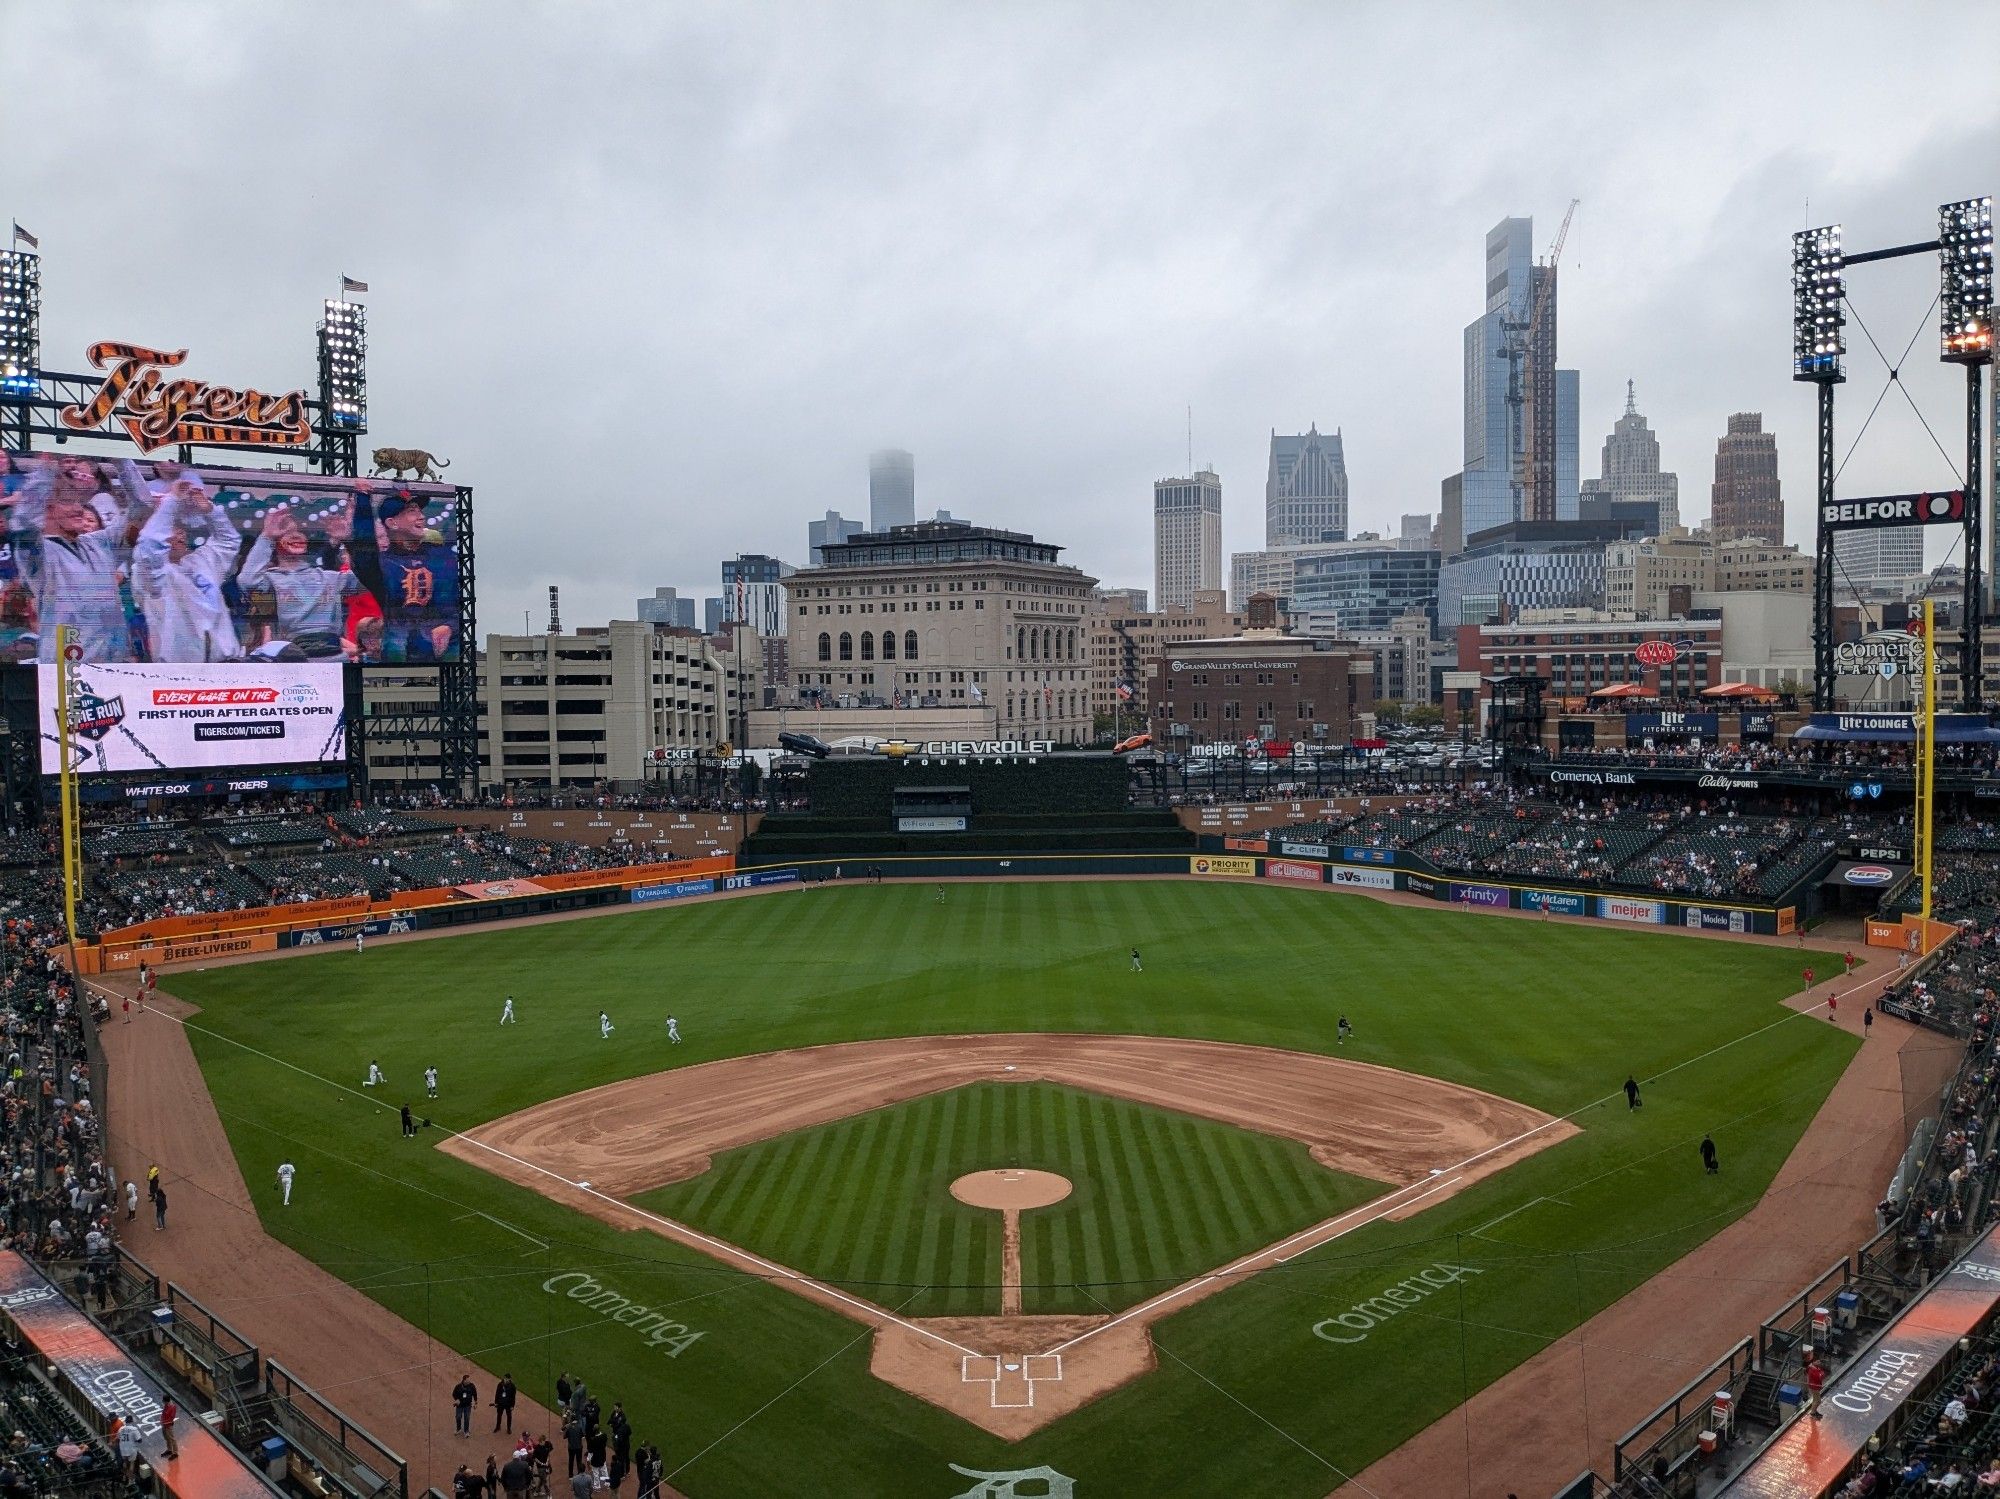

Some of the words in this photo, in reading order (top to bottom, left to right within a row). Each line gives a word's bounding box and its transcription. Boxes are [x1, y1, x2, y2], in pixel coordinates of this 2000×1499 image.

[60, 340, 312, 456] Tigers
[1824, 500, 1912, 522] BELFOR
[1906, 603, 1926, 706] ROCKET
[157, 692, 193, 704] EVERY
[197, 691, 228, 702] GAME
[233, 690, 250, 701] ON
[251, 690, 272, 700] THE
[96, 699, 122, 719] RUN
[138, 710, 178, 720] FIRST
[180, 709, 214, 718] HOUR
[217, 708, 258, 718] AFTER
[260, 707, 300, 716] GATES
[302, 706, 333, 716] OPEN
[1661, 711, 1686, 726] Lite
[1840, 716, 1864, 731] Lite
[1864, 719, 1908, 729] LOUNGE
[199, 725, 281, 737] TIGERS.COM/TICKETS
[927, 740, 1056, 754] CHEVROLET
[1191, 742, 1238, 758] meijer
[1365, 748, 1388, 756] LAW
[647, 749, 695, 760] ROCKET
[903, 758, 1037, 766] FOUNTAIN
[1605, 773, 1636, 784] Bank
[1698, 774, 1733, 790] Bally
[1732, 780, 1758, 788] SPORTS
[125, 786, 164, 796] WHITE
[164, 784, 191, 794] SOX
[228, 780, 268, 790] TIGERS
[1326, 800, 1334, 808] 11
[512, 812, 524, 821] 23
[678, 814, 687, 822] 16
[722, 816, 728, 824] 6
[615, 829, 626, 837] 47
[659, 829, 664, 837] 3
[1298, 846, 1327, 854] CLIFFS
[1860, 848, 1900, 860] PEPSI
[1212, 860, 1250, 868] PRIORITY
[727, 876, 752, 889] DTE
[1362, 876, 1390, 884] VISION
[1460, 887, 1500, 904] xfinity
[1541, 894, 1578, 906] McLaren
[1611, 902, 1651, 919] meijer
[1702, 914, 1728, 925] Modelo
